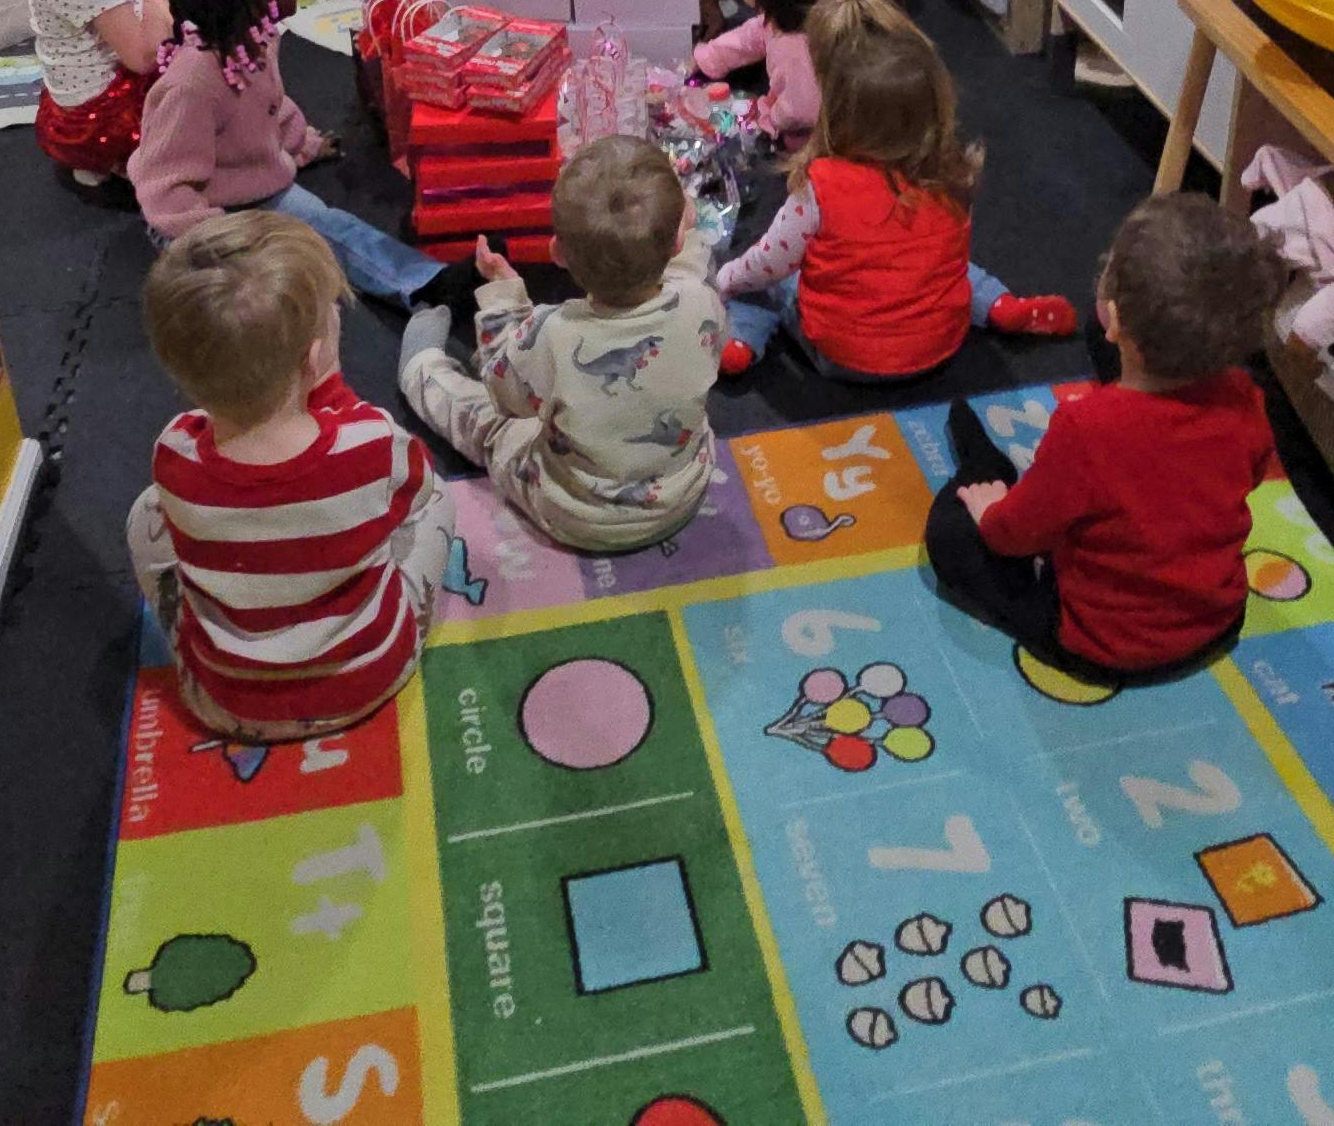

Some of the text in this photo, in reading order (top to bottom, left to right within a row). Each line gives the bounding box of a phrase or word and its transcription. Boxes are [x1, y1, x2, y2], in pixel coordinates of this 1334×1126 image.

[821, 424, 891, 501] Yy
[781, 608, 881, 658] 6
[127, 686, 164, 825] umbrella
[458, 685, 489, 775] circle
[1119, 759, 1243, 830] 2
[784, 810, 839, 928] seven
[867, 814, 992, 875] 7
[478, 879, 518, 1021] square
